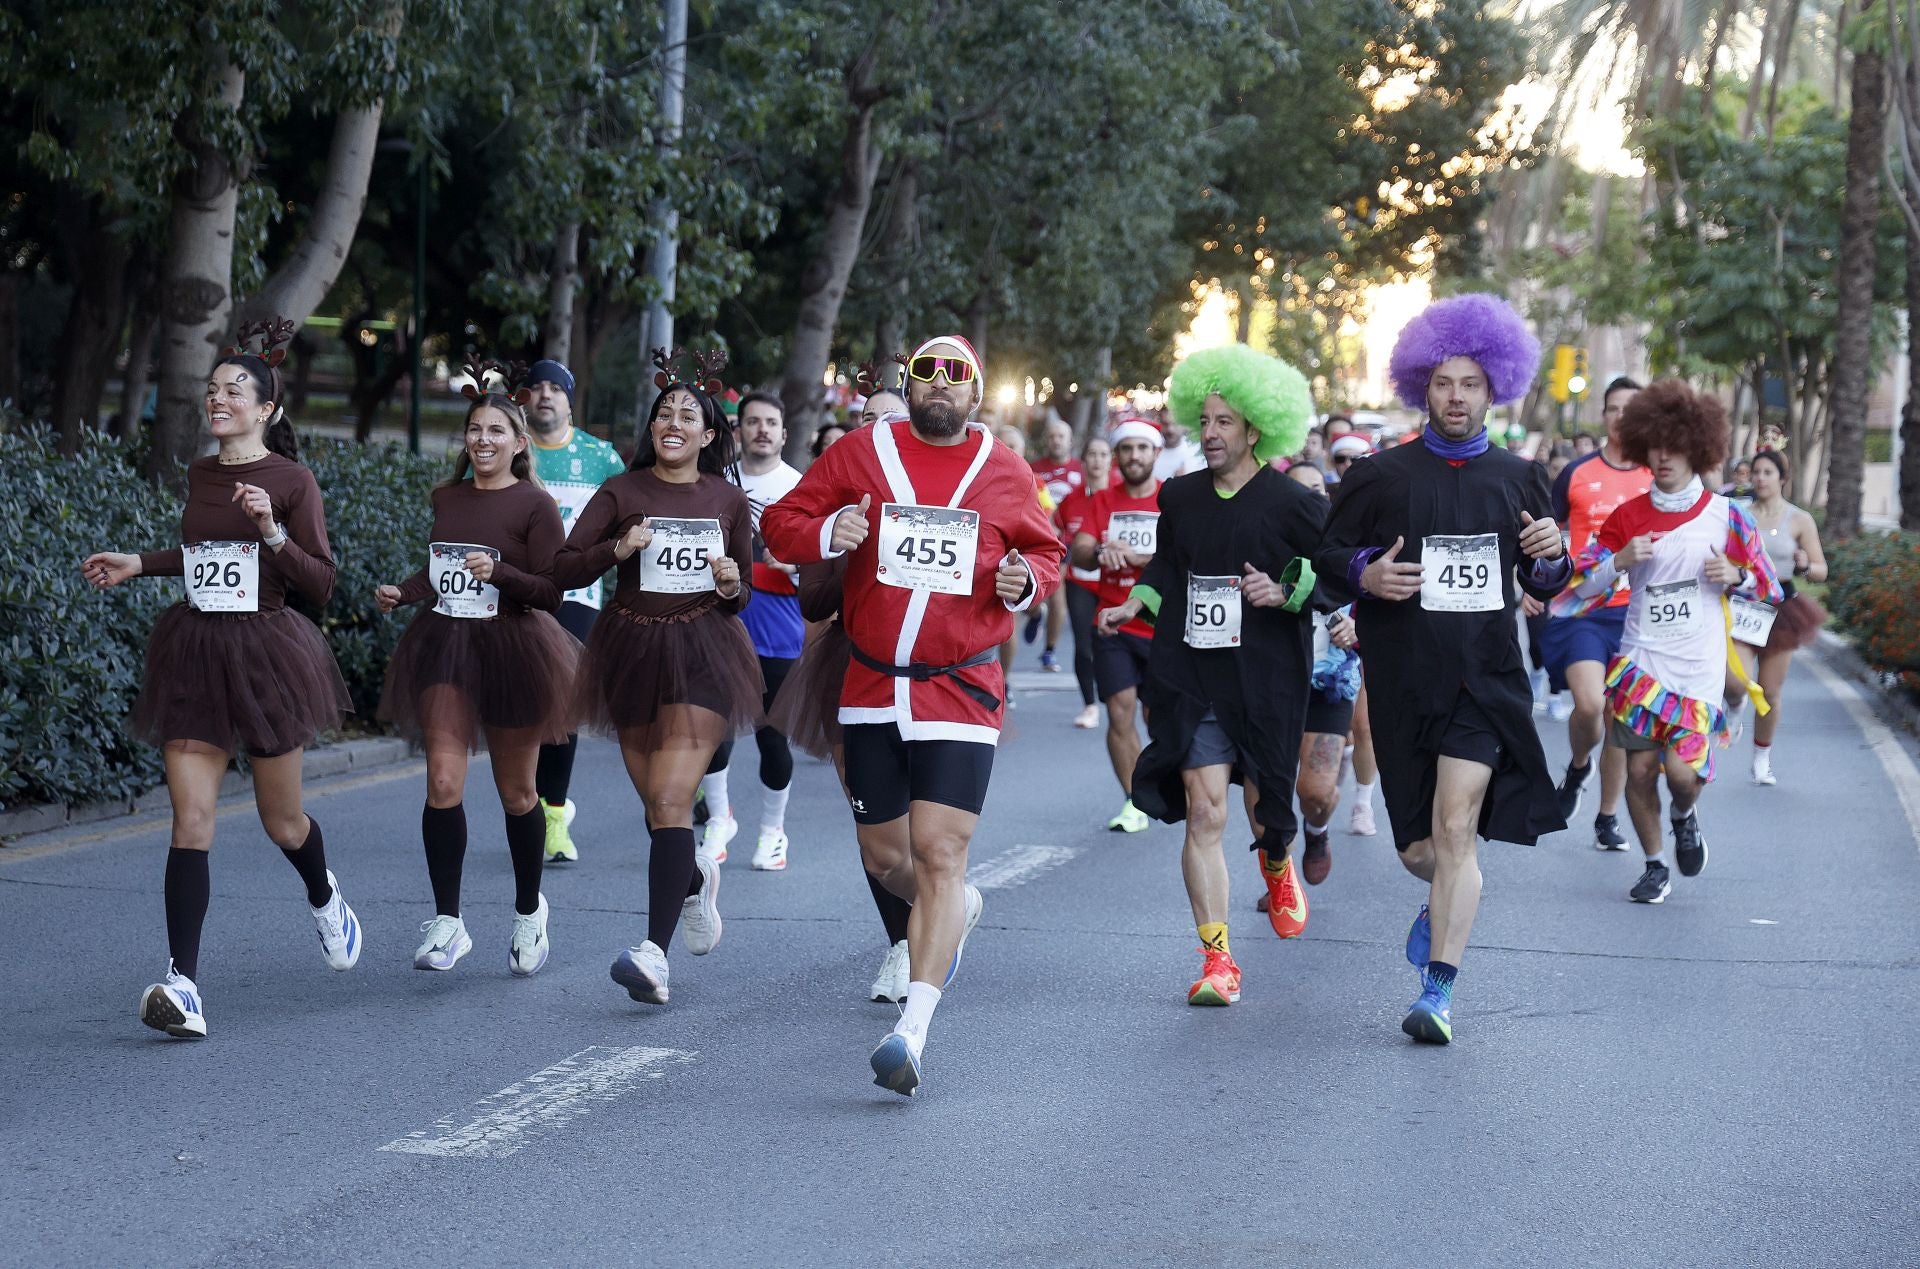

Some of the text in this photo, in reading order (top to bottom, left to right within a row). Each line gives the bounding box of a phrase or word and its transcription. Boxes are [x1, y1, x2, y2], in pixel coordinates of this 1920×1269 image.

[656, 546, 709, 572] 465
[896, 536, 957, 568] 455
[193, 561, 241, 590] 926
[440, 570, 485, 596] 604
[1438, 563, 1489, 589] 459
[1649, 601, 1691, 623] 594
